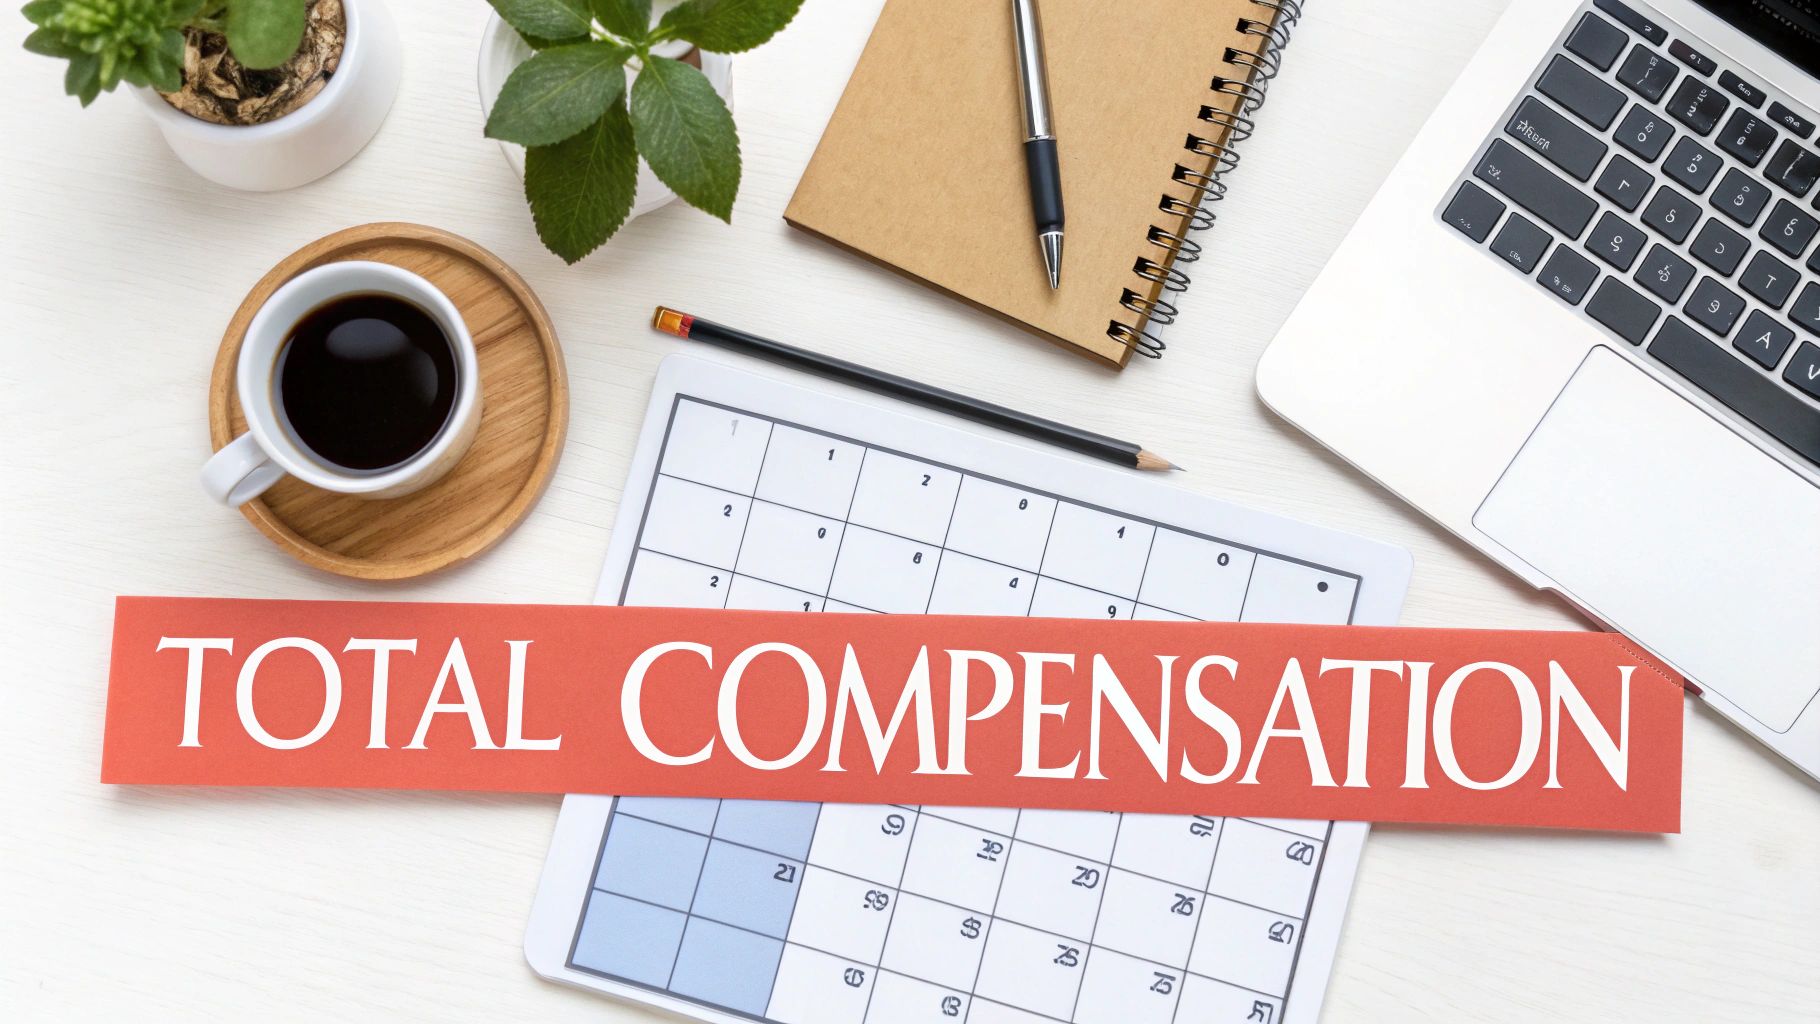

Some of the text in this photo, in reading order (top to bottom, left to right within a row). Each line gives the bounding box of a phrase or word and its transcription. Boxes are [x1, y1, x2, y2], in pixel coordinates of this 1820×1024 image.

[1755, 331, 1771, 349] A
[828, 448, 835, 461] 1
[921, 474, 932, 487] 2
[723, 504, 733, 517] 2
[709, 575, 720, 588] 2
[1107, 604, 1117, 619] 9
[156, 637, 1637, 792] TOTAL COMPENSATION
[773, 862, 798, 884] 21
